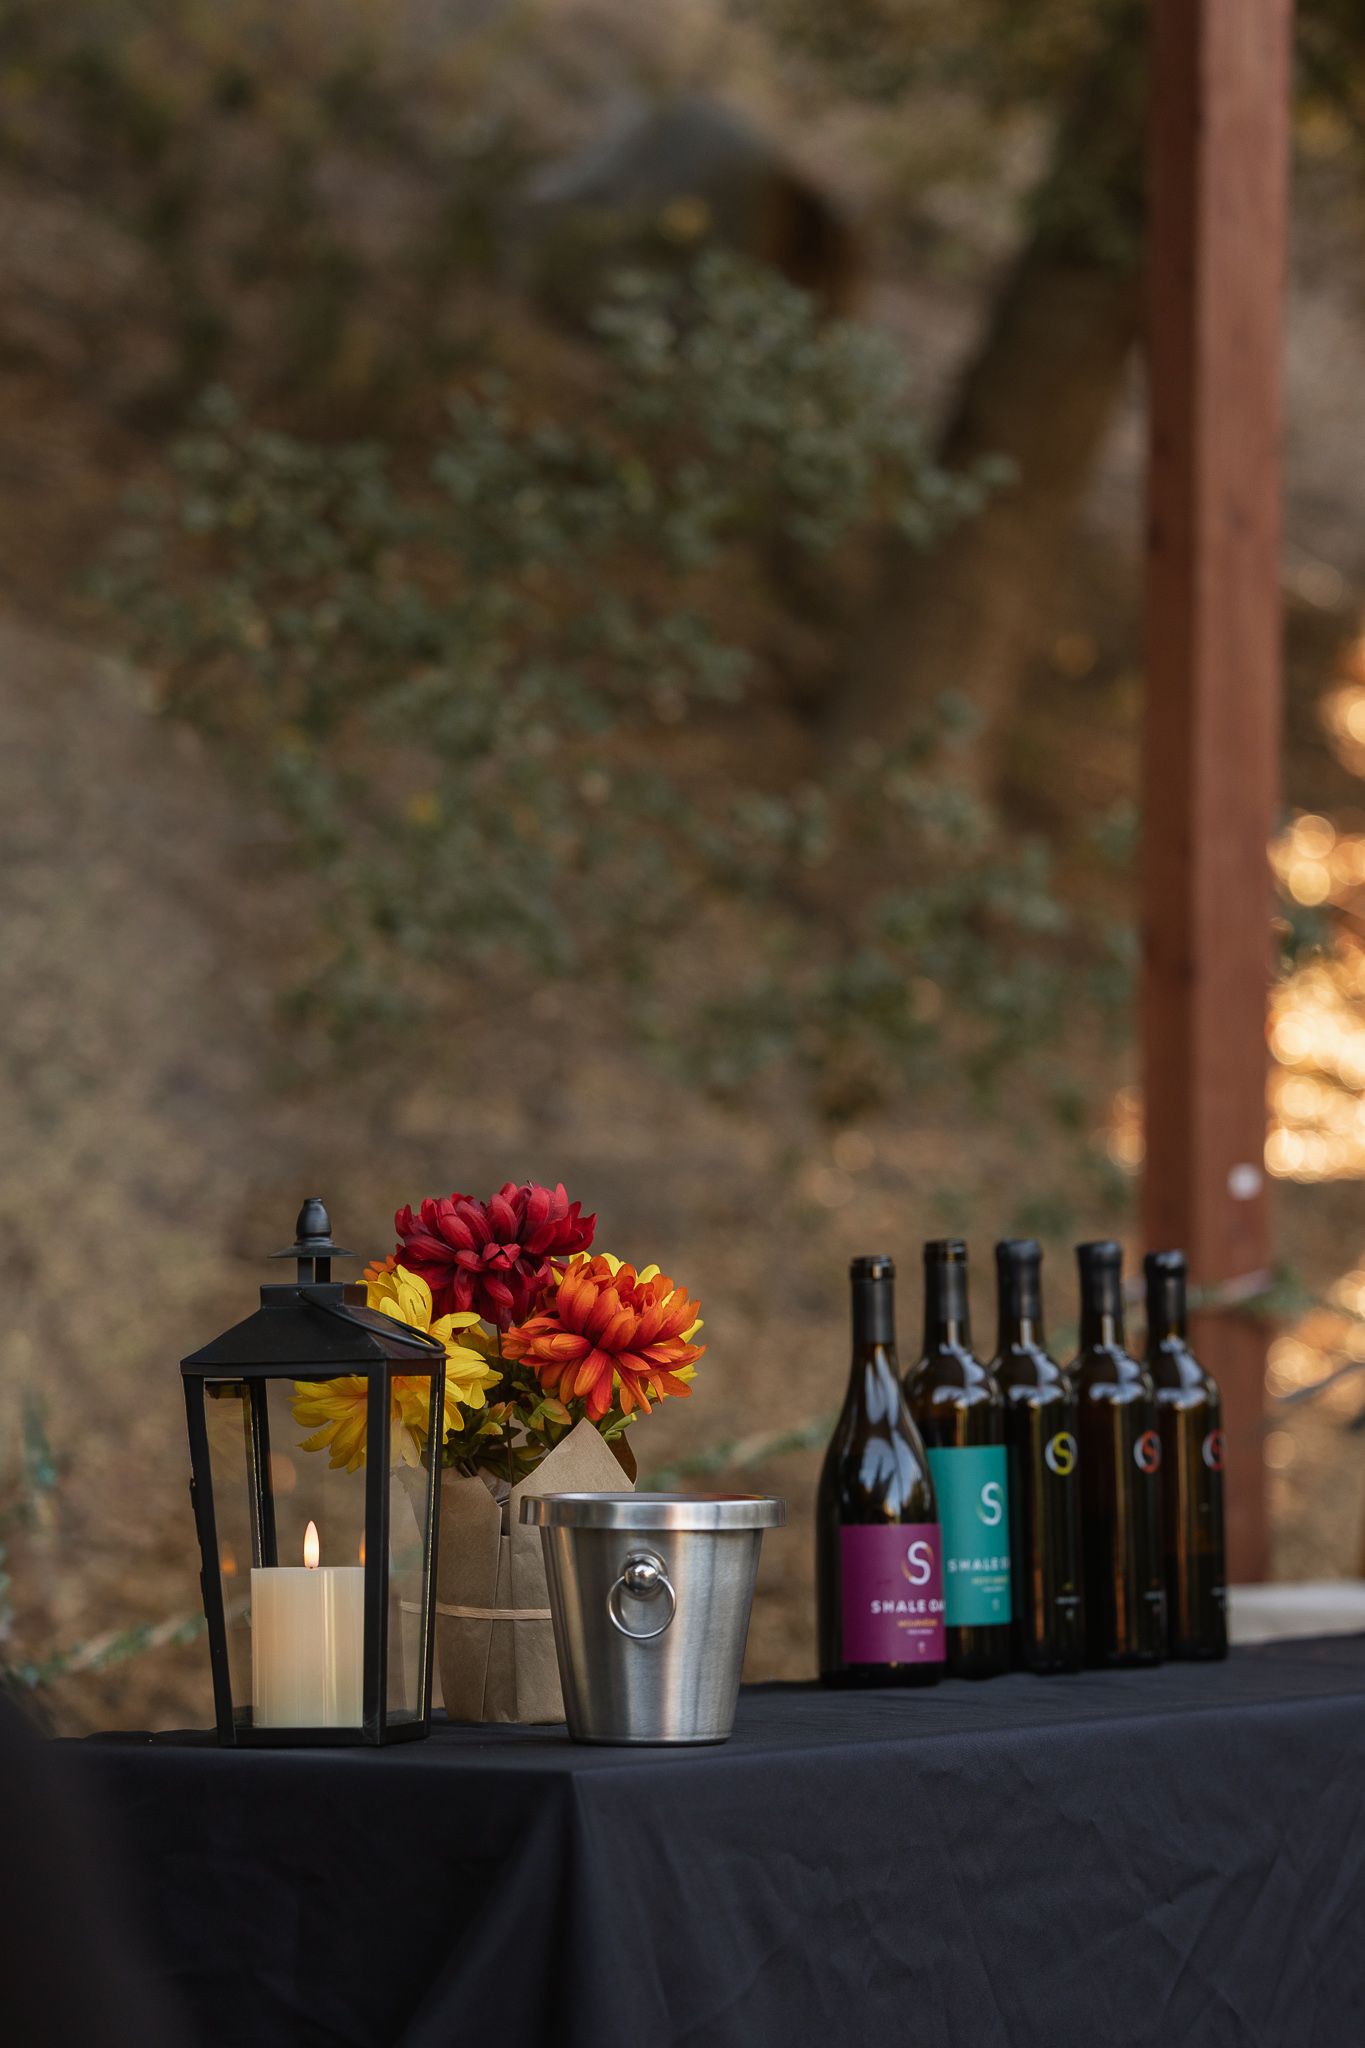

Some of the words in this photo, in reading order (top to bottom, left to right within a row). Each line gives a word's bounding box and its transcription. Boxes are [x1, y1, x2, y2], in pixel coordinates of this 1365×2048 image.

[1052, 1431, 1074, 1476] S
[980, 1481, 1002, 1526] S
[906, 1540, 931, 1586] S
[947, 1557, 999, 1573] SHALE
[870, 1599, 926, 1614] SHALE
[928, 1598, 946, 1613] OA
